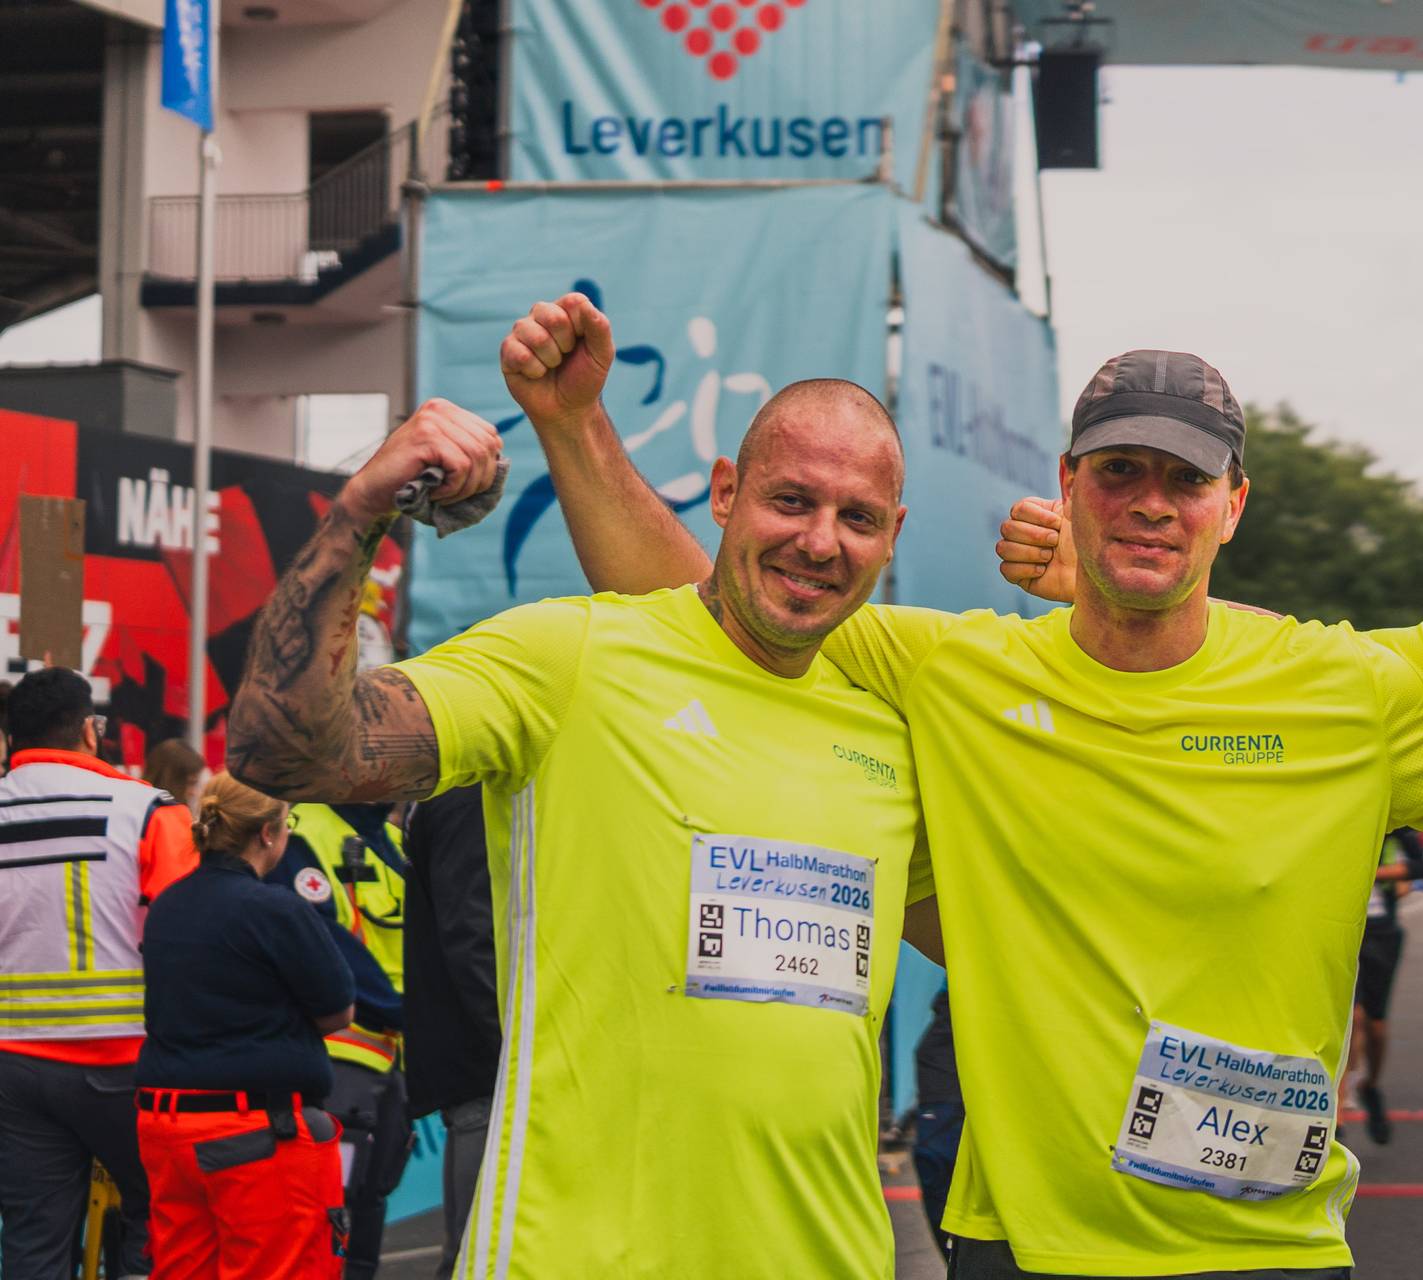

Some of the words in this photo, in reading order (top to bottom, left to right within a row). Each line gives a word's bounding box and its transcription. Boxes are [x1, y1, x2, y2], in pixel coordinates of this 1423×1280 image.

[562, 100, 882, 157] Leverkusen
[117, 467, 221, 554] NÄHE
[1181, 735, 1284, 752] CURRENTA
[1223, 752, 1284, 765] GRUPPE
[832, 744, 897, 784] CURRENTA
[709, 845, 764, 872] EVL
[766, 850, 867, 883] HalbMarathon
[716, 873, 827, 899] Leverkusen
[830, 882, 871, 910] 2026
[732, 906, 851, 951] Thomas
[774, 954, 820, 976] 2462
[1159, 1036, 1212, 1070] EVL
[1215, 1054, 1325, 1086] HalbMarathon
[1161, 1062, 1278, 1104] Leverkusen
[1281, 1088, 1329, 1112] 2026
[1196, 1106, 1270, 1146] Alex
[1199, 1147, 1248, 1172] 2381
